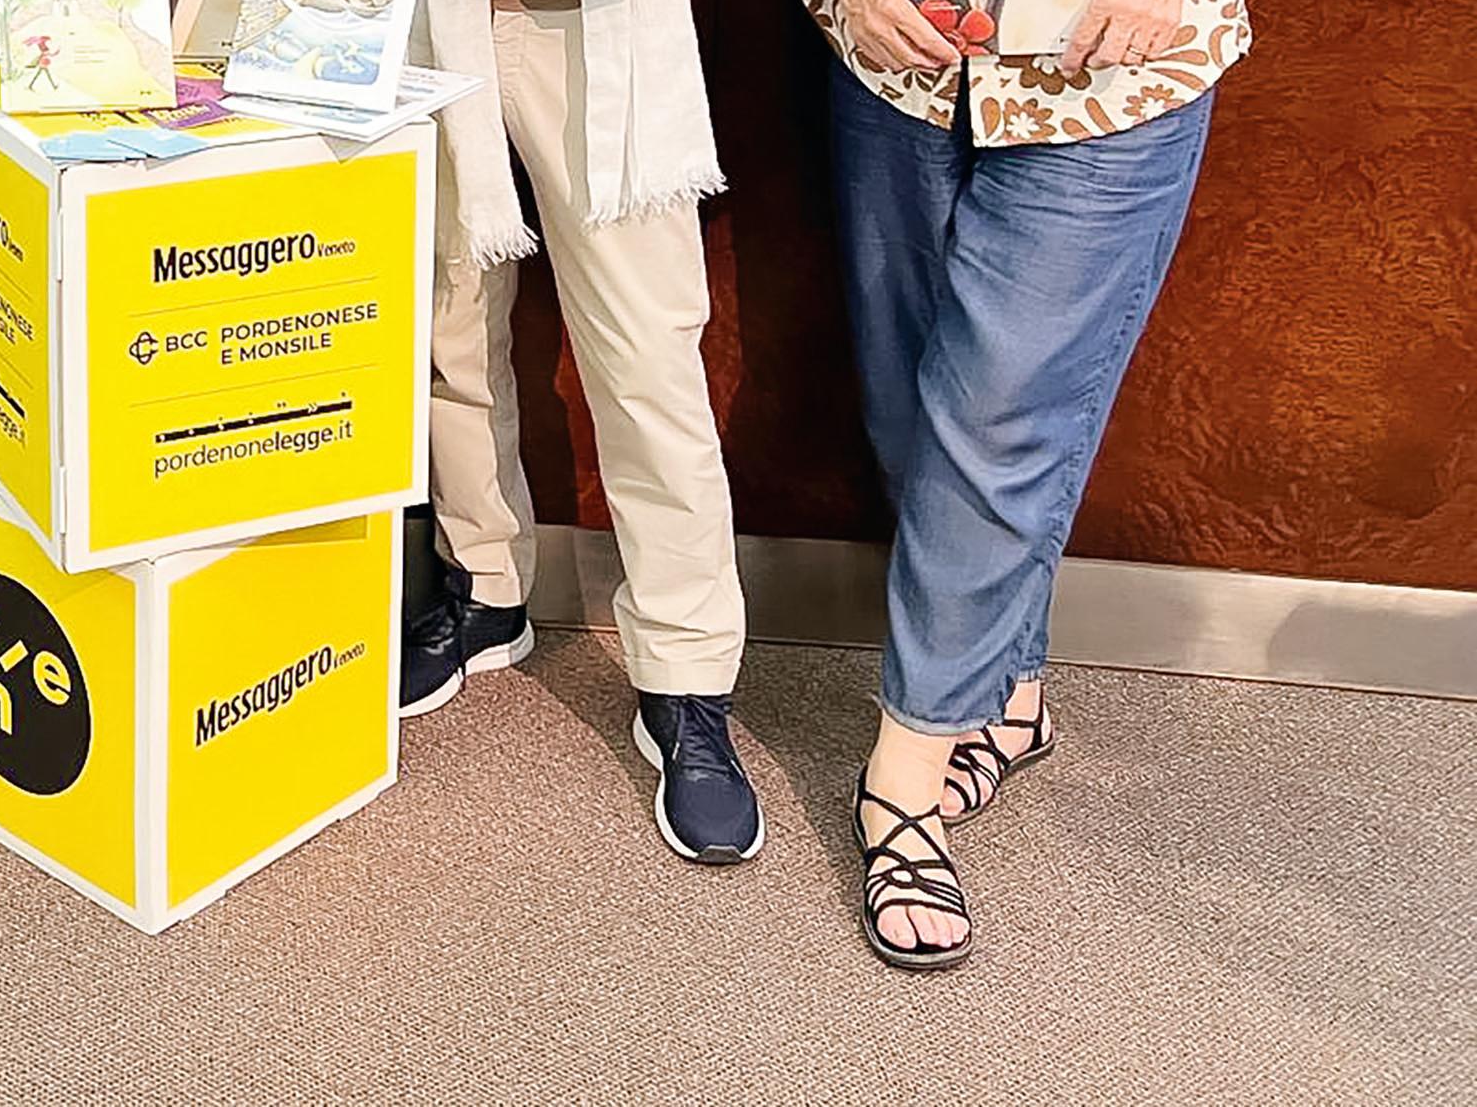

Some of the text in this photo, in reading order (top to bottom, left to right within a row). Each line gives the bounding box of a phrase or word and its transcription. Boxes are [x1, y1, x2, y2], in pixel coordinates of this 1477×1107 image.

[154, 232, 355, 283] Messaggero Veneto
[166, 303, 378, 352] BCC PORDENONESE
[221, 333, 332, 365] E MONSILE
[154, 420, 352, 479] pordenonelegge.it
[195, 645, 332, 748] Messaggero
